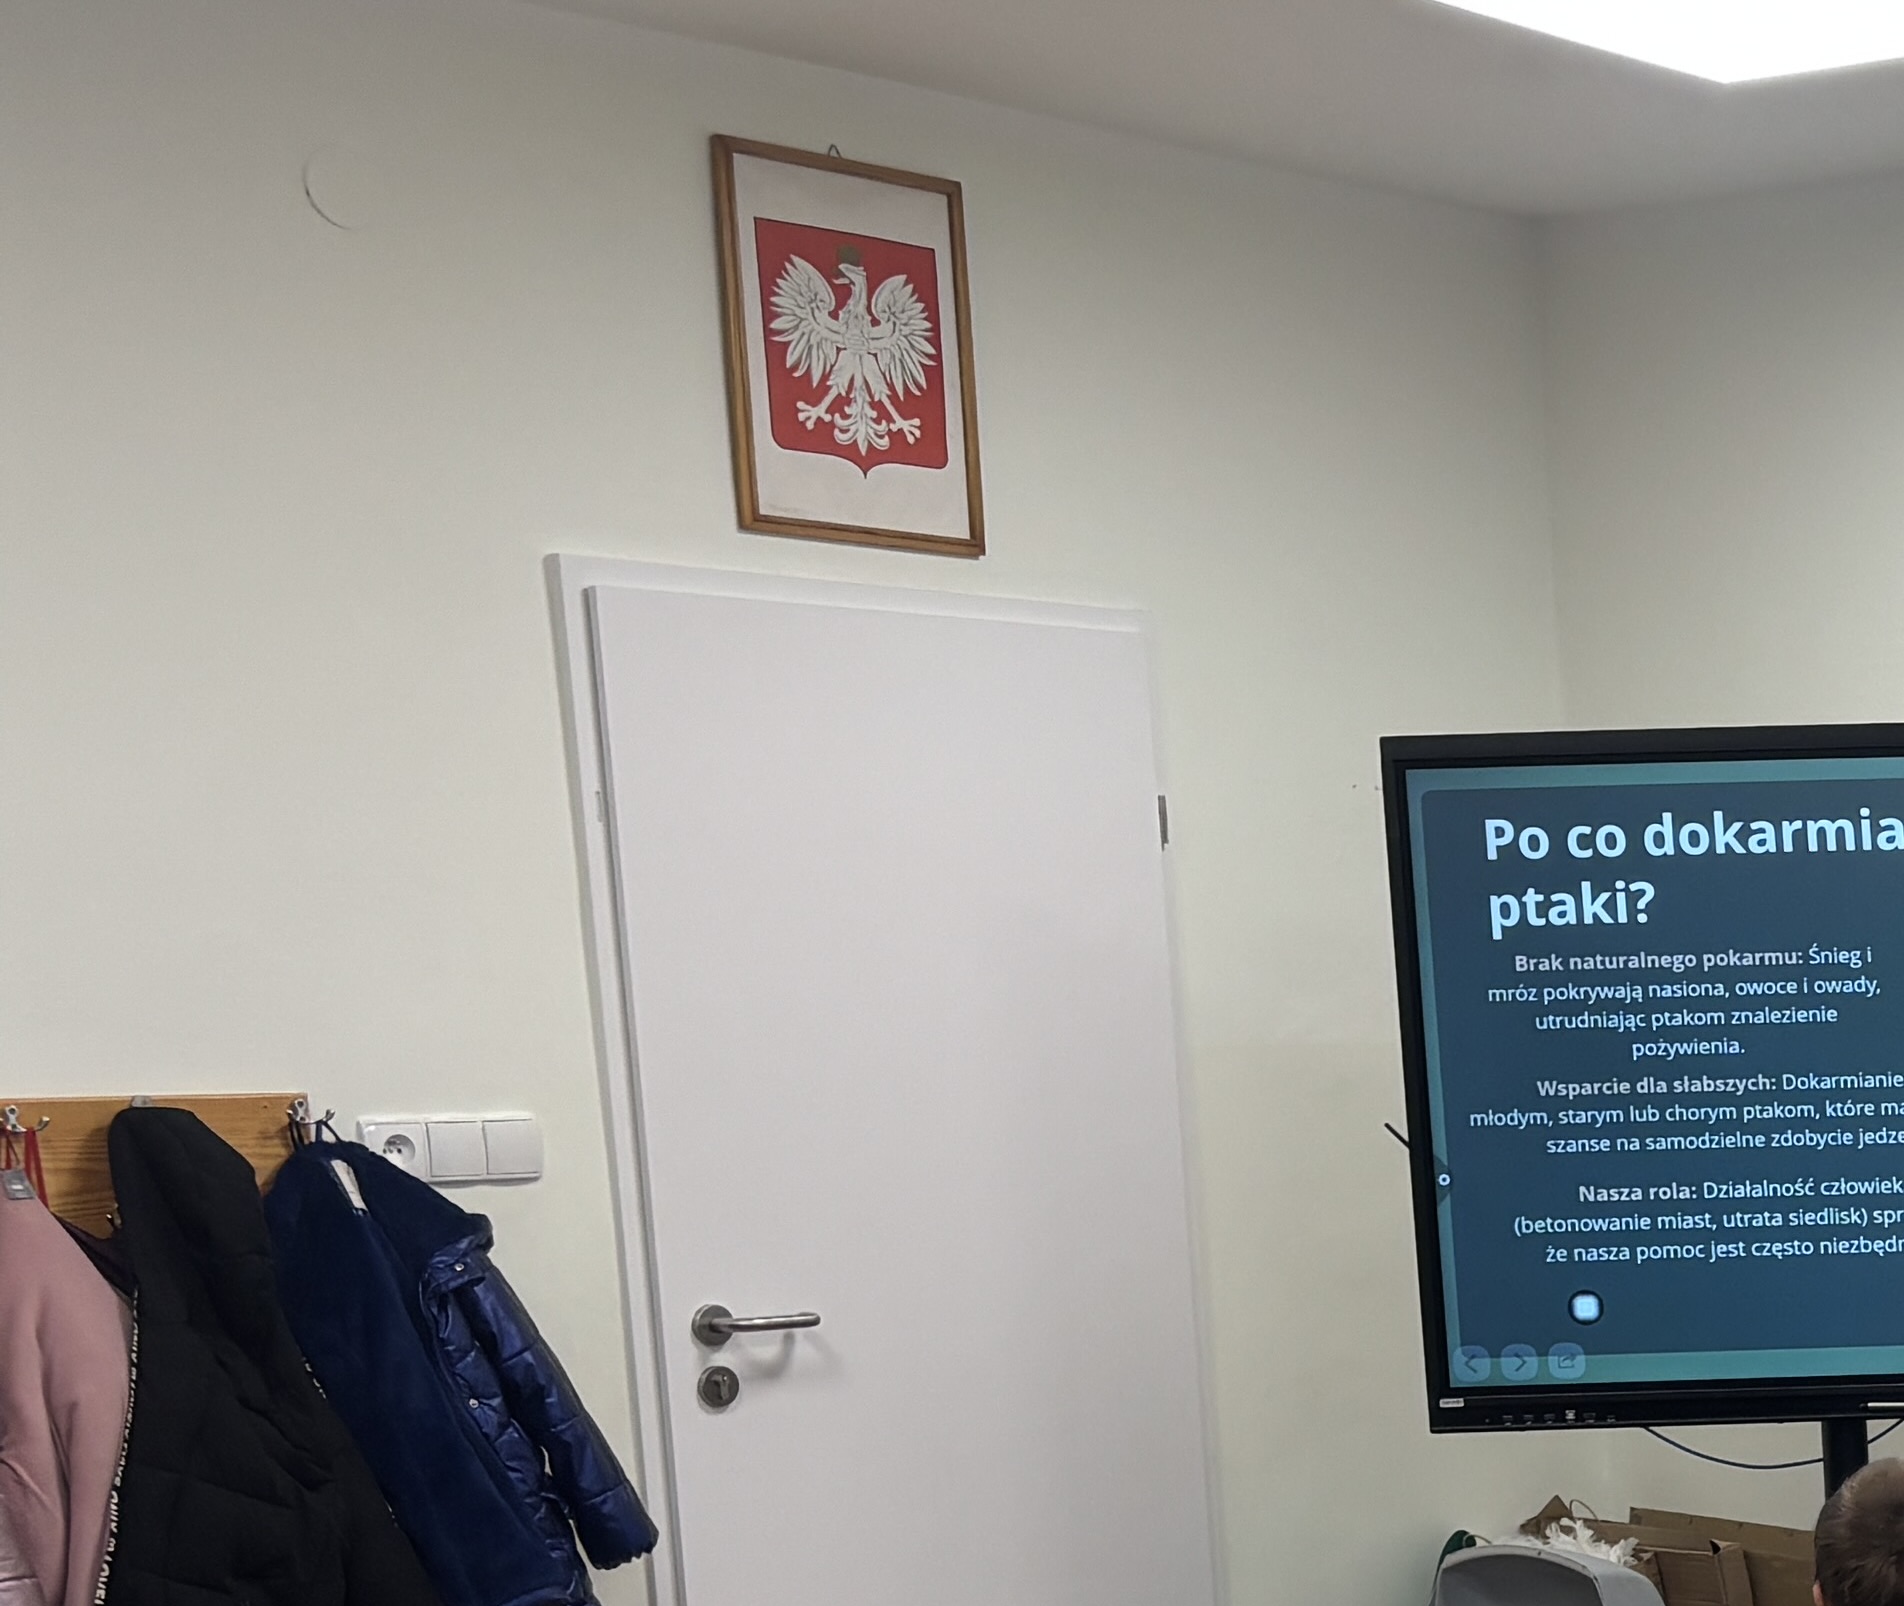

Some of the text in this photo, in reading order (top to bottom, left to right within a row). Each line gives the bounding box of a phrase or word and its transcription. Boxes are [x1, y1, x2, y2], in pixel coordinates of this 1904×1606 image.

[1485, 818, 1549, 860] Po
[1567, 824, 1626, 859] co
[1490, 880, 1655, 940] ptaki?
[1515, 944, 1872, 973] Brak naturalnego pokarmu: Śnieg i
[1488, 976, 1880, 1005] mróz pokrywają nasiona, owoce i owady,
[1536, 1005, 1838, 1033] utrudniając ptakom znalezienie
[1632, 1036, 1745, 1061] pożywienia.
[1537, 1078, 1631, 1100] Wsparcie
[1637, 1076, 1668, 1095] dla
[1673, 1073, 1776, 1096] słabszych:
[1783, 1071, 1904, 1091] Dokarmianie
[1470, 1108, 1553, 1130] młodym,
[1559, 1106, 1624, 1128] starym
[1630, 1104, 1660, 1122] lub
[1665, 1102, 1736, 1125] chorym
[1743, 1100, 1820, 1122] ptakom,
[1825, 1098, 1875, 1118] które
[1547, 1136, 1610, 1154] szanse
[1617, 1135, 1639, 1151] na
[1646, 1131, 1765, 1151] samodzielne
[1771, 1129, 1853, 1149] zdobycie
[1579, 1184, 1643, 1203] Nasza
[1650, 1182, 1697, 1200] rola:
[1703, 1178, 1815, 1200] Działalność
[1514, 1212, 1651, 1237] (betonowanie
[1657, 1211, 1718, 1232] miast,
[1723, 1210, 1783, 1228] utrata
[1788, 1207, 1868, 1228] siedlisk)
[1547, 1245, 1567, 1264] że
[1574, 1244, 1630, 1261] nasza
[1637, 1242, 1705, 1265] pomoc
[1709, 1240, 1746, 1261] jest
[1751, 1238, 1814, 1260] często
